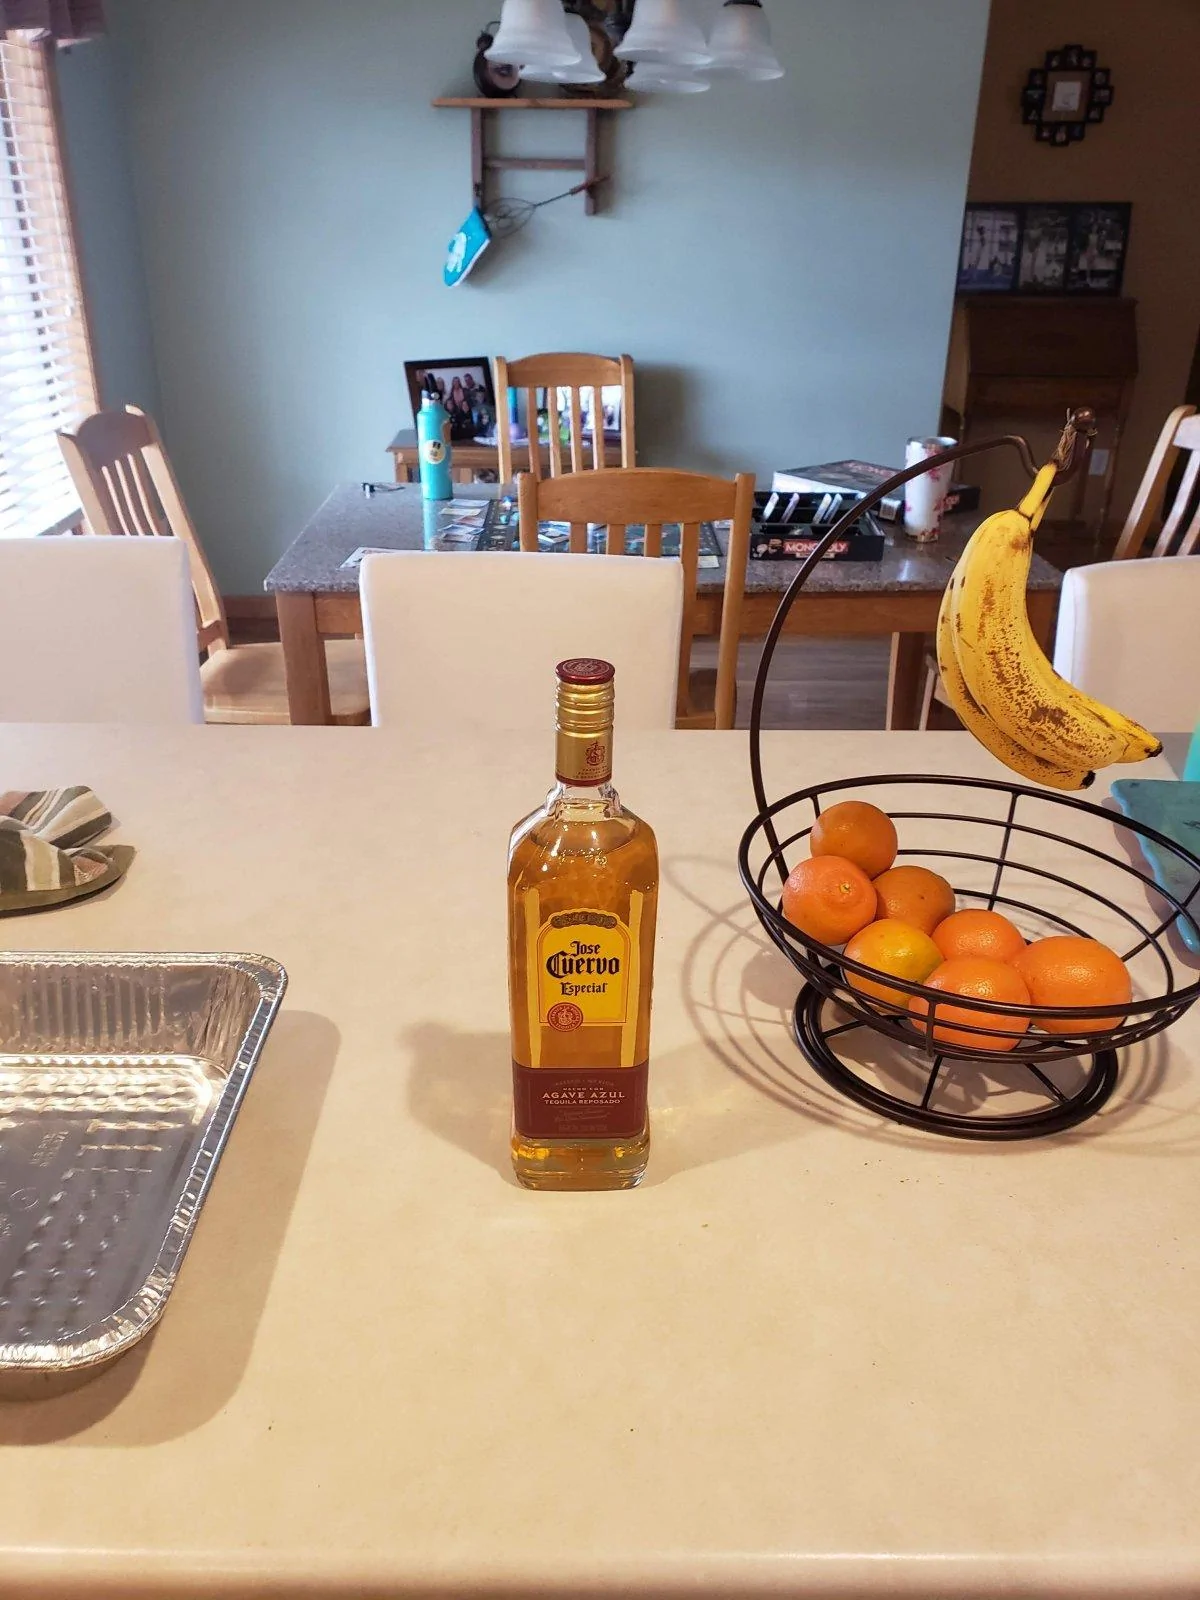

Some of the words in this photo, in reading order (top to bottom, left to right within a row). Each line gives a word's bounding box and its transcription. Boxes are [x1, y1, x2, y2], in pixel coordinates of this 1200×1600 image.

[570, 940, 601, 957] Jose
[546, 951, 620, 979] Cuervo
[560, 982, 608, 996] Especial
[542, 1091, 585, 1099] AGAVE
[590, 1091, 625, 1099] AZUL
